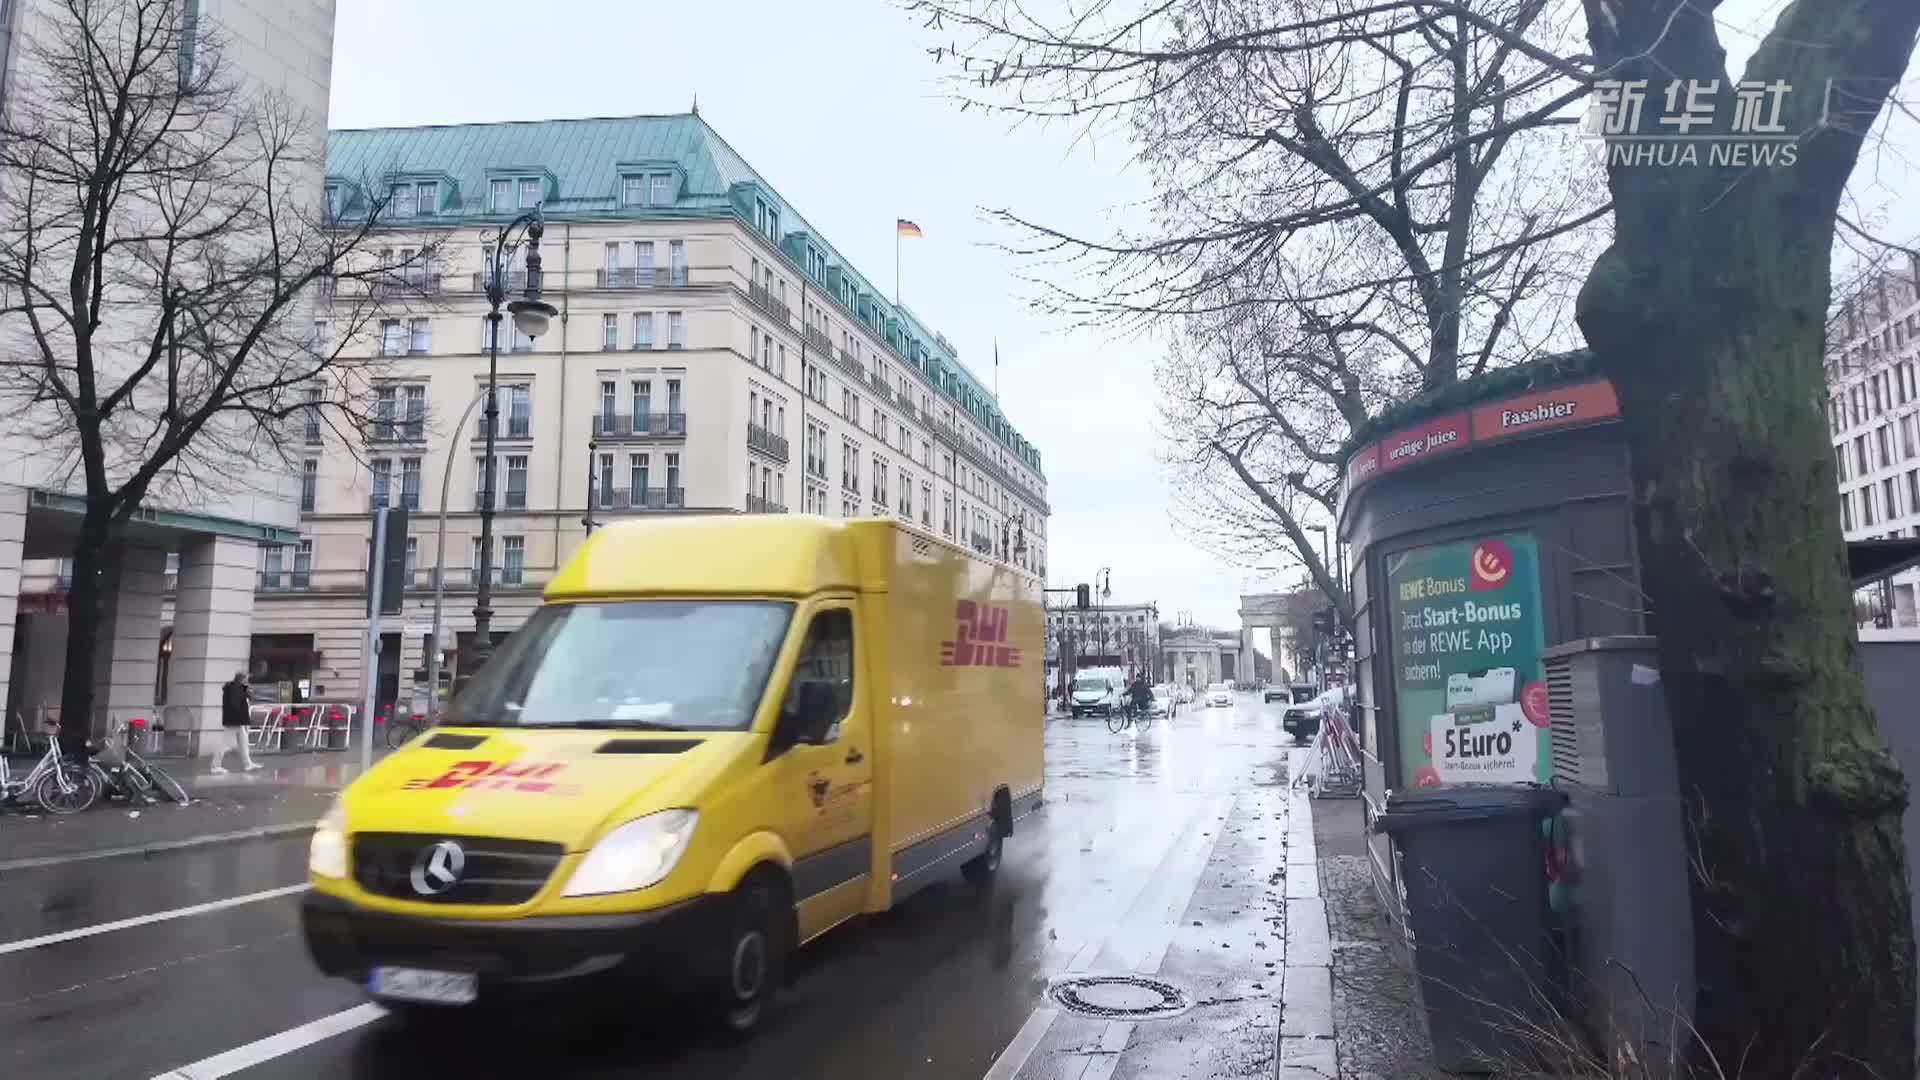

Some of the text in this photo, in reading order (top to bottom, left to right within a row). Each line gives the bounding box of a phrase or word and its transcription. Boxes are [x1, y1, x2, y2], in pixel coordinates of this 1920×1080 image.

[1501, 401, 1576, 428] Fassbier
[1400, 576, 1466, 601] REWE Bonus
[1401, 600, 1522, 631] Jetzt Start-Bonus
[948, 599, 1018, 667] DHL
[1412, 635, 1427, 655] der
[1430, 630, 1473, 653] REWE
[1477, 629, 1513, 655] App
[1404, 658, 1441, 681] sichern!
[1445, 729, 1456, 759] 5
